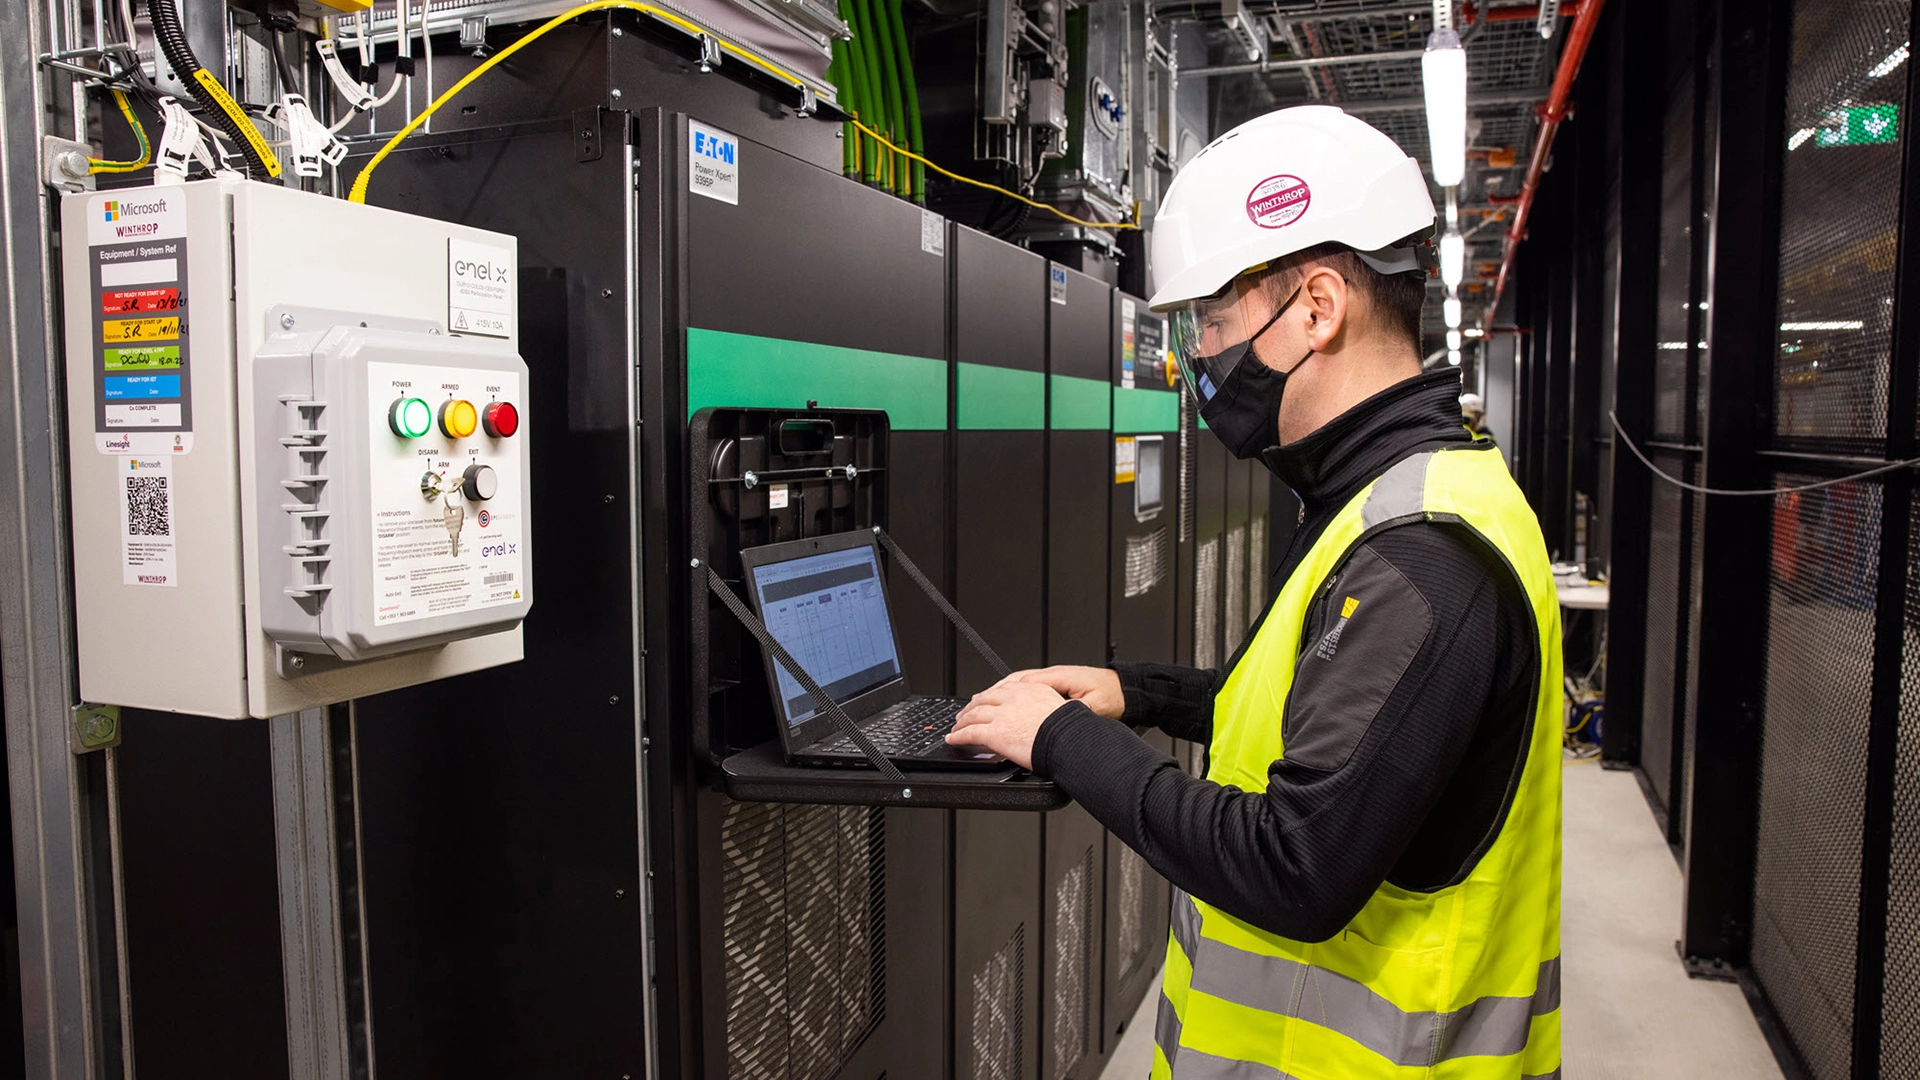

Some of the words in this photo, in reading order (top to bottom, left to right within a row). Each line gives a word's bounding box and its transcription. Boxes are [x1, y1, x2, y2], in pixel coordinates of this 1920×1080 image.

[695, 131, 734, 165] EATON
[695, 161, 714, 177] Power
[695, 174, 714, 188] 9395P
[1250, 187, 1306, 213] WINTHROP
[121, 198, 167, 217] Microsoft
[116, 223, 158, 237] WINTHROP
[100, 248, 135, 260] Equipment
[139, 246, 164, 258] System
[164, 244, 177, 253] Ref
[455, 260, 492, 281] enel
[475, 319, 490, 328] 415V
[492, 321, 504, 330] 10A
[392, 380, 412, 388] POWER
[441, 383, 460, 391] ARMED
[486, 385, 501, 393] EVENT
[105, 440, 130, 449] Linesight
[138, 460, 161, 469] Microsoft
[482, 541, 506, 558] enel
[137, 575, 167, 583] WINTHROP
